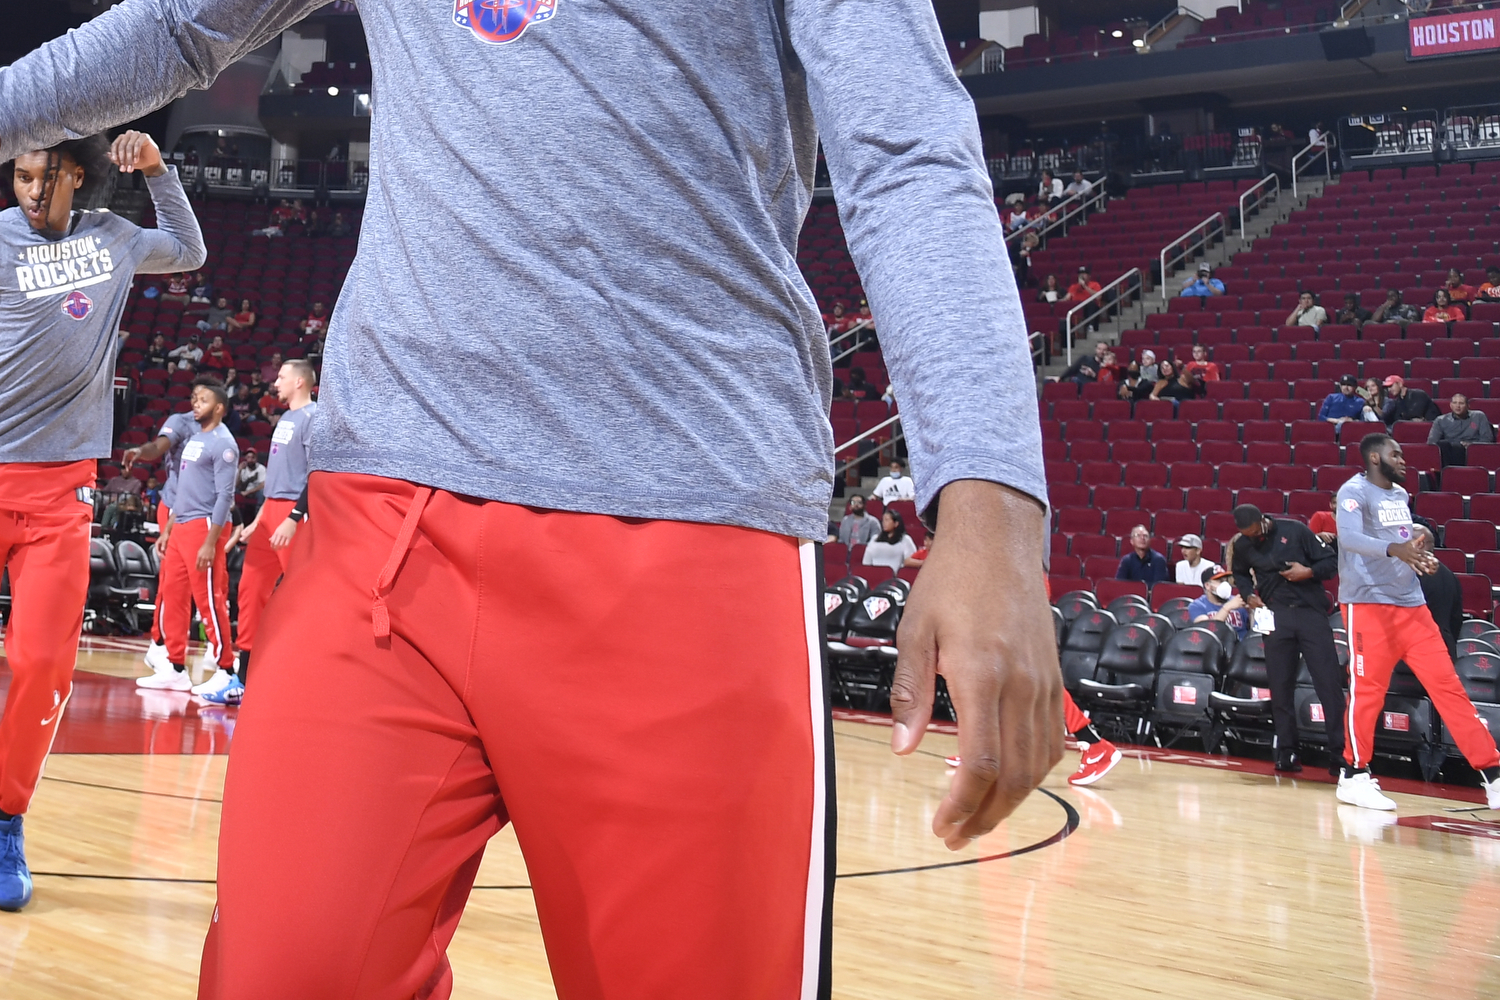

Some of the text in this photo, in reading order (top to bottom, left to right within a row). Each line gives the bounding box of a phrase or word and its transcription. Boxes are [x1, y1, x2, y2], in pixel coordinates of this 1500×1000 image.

[1413, 17, 1495, 47] HOUSTON
[26, 235, 98, 264] HOUSTON
[16, 248, 114, 292] ROCKETS
